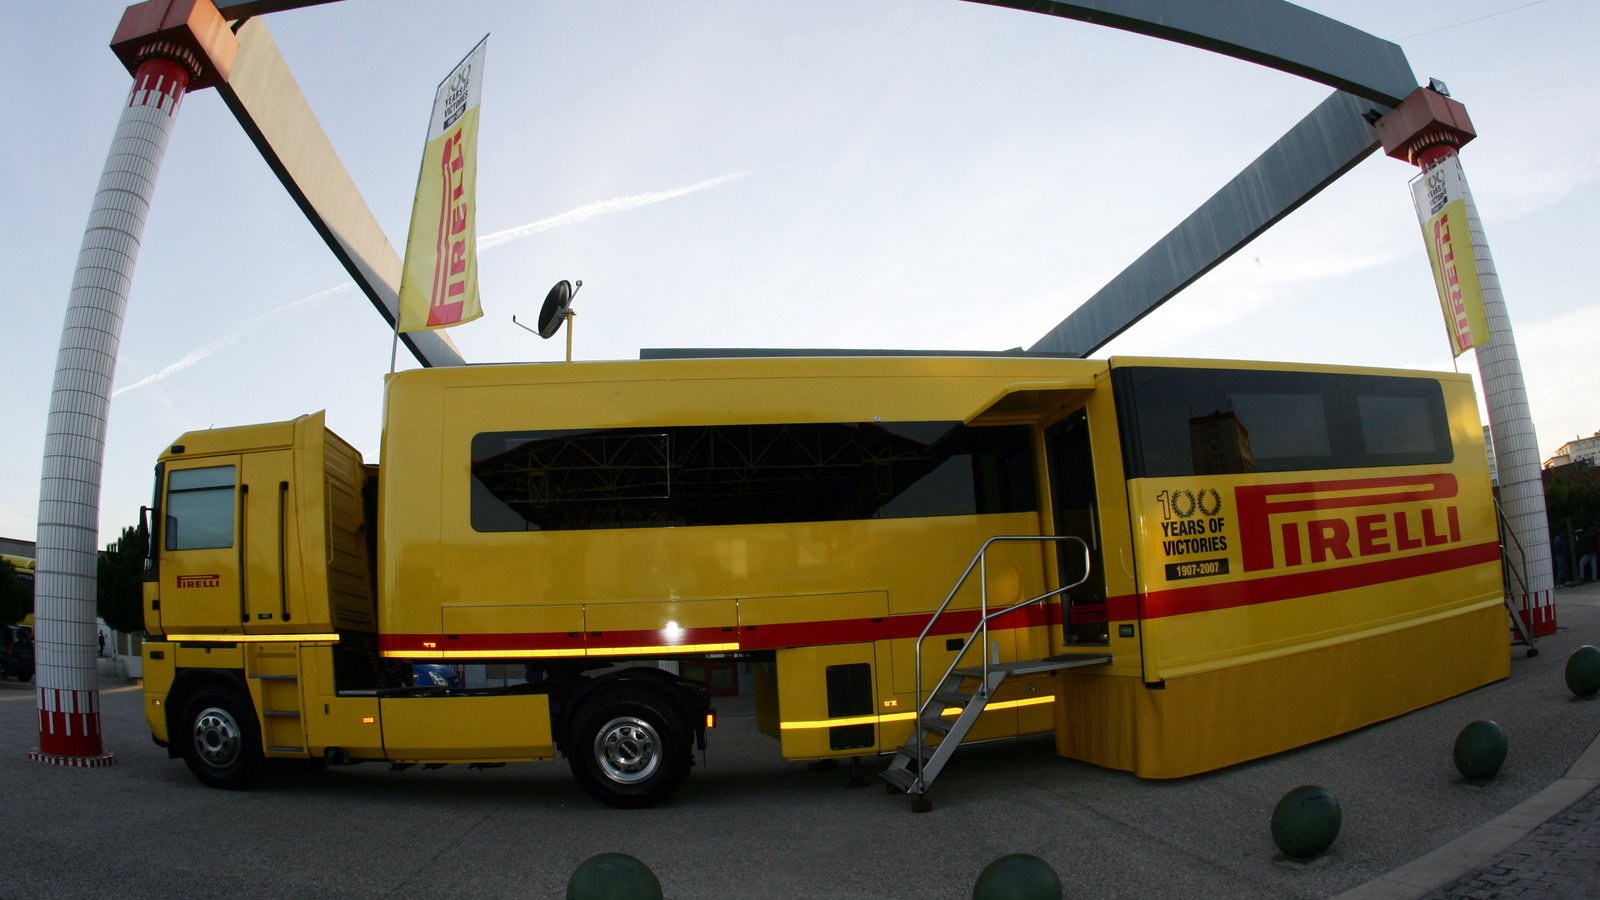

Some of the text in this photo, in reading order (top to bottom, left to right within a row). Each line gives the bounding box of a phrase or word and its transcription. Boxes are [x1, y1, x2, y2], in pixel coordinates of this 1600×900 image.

[426, 127, 467, 327] PIRELLI
[1433, 213, 1473, 351] PIRELLI
[1156, 488, 1221, 520] 100
[1161, 518, 1225, 537] YEARS OF
[1234, 473, 1461, 572] PIRELLI
[1163, 536, 1227, 556] VICTORIES
[177, 574, 220, 588] PIRELLI
[1177, 562, 1219, 577] 1907-2007
